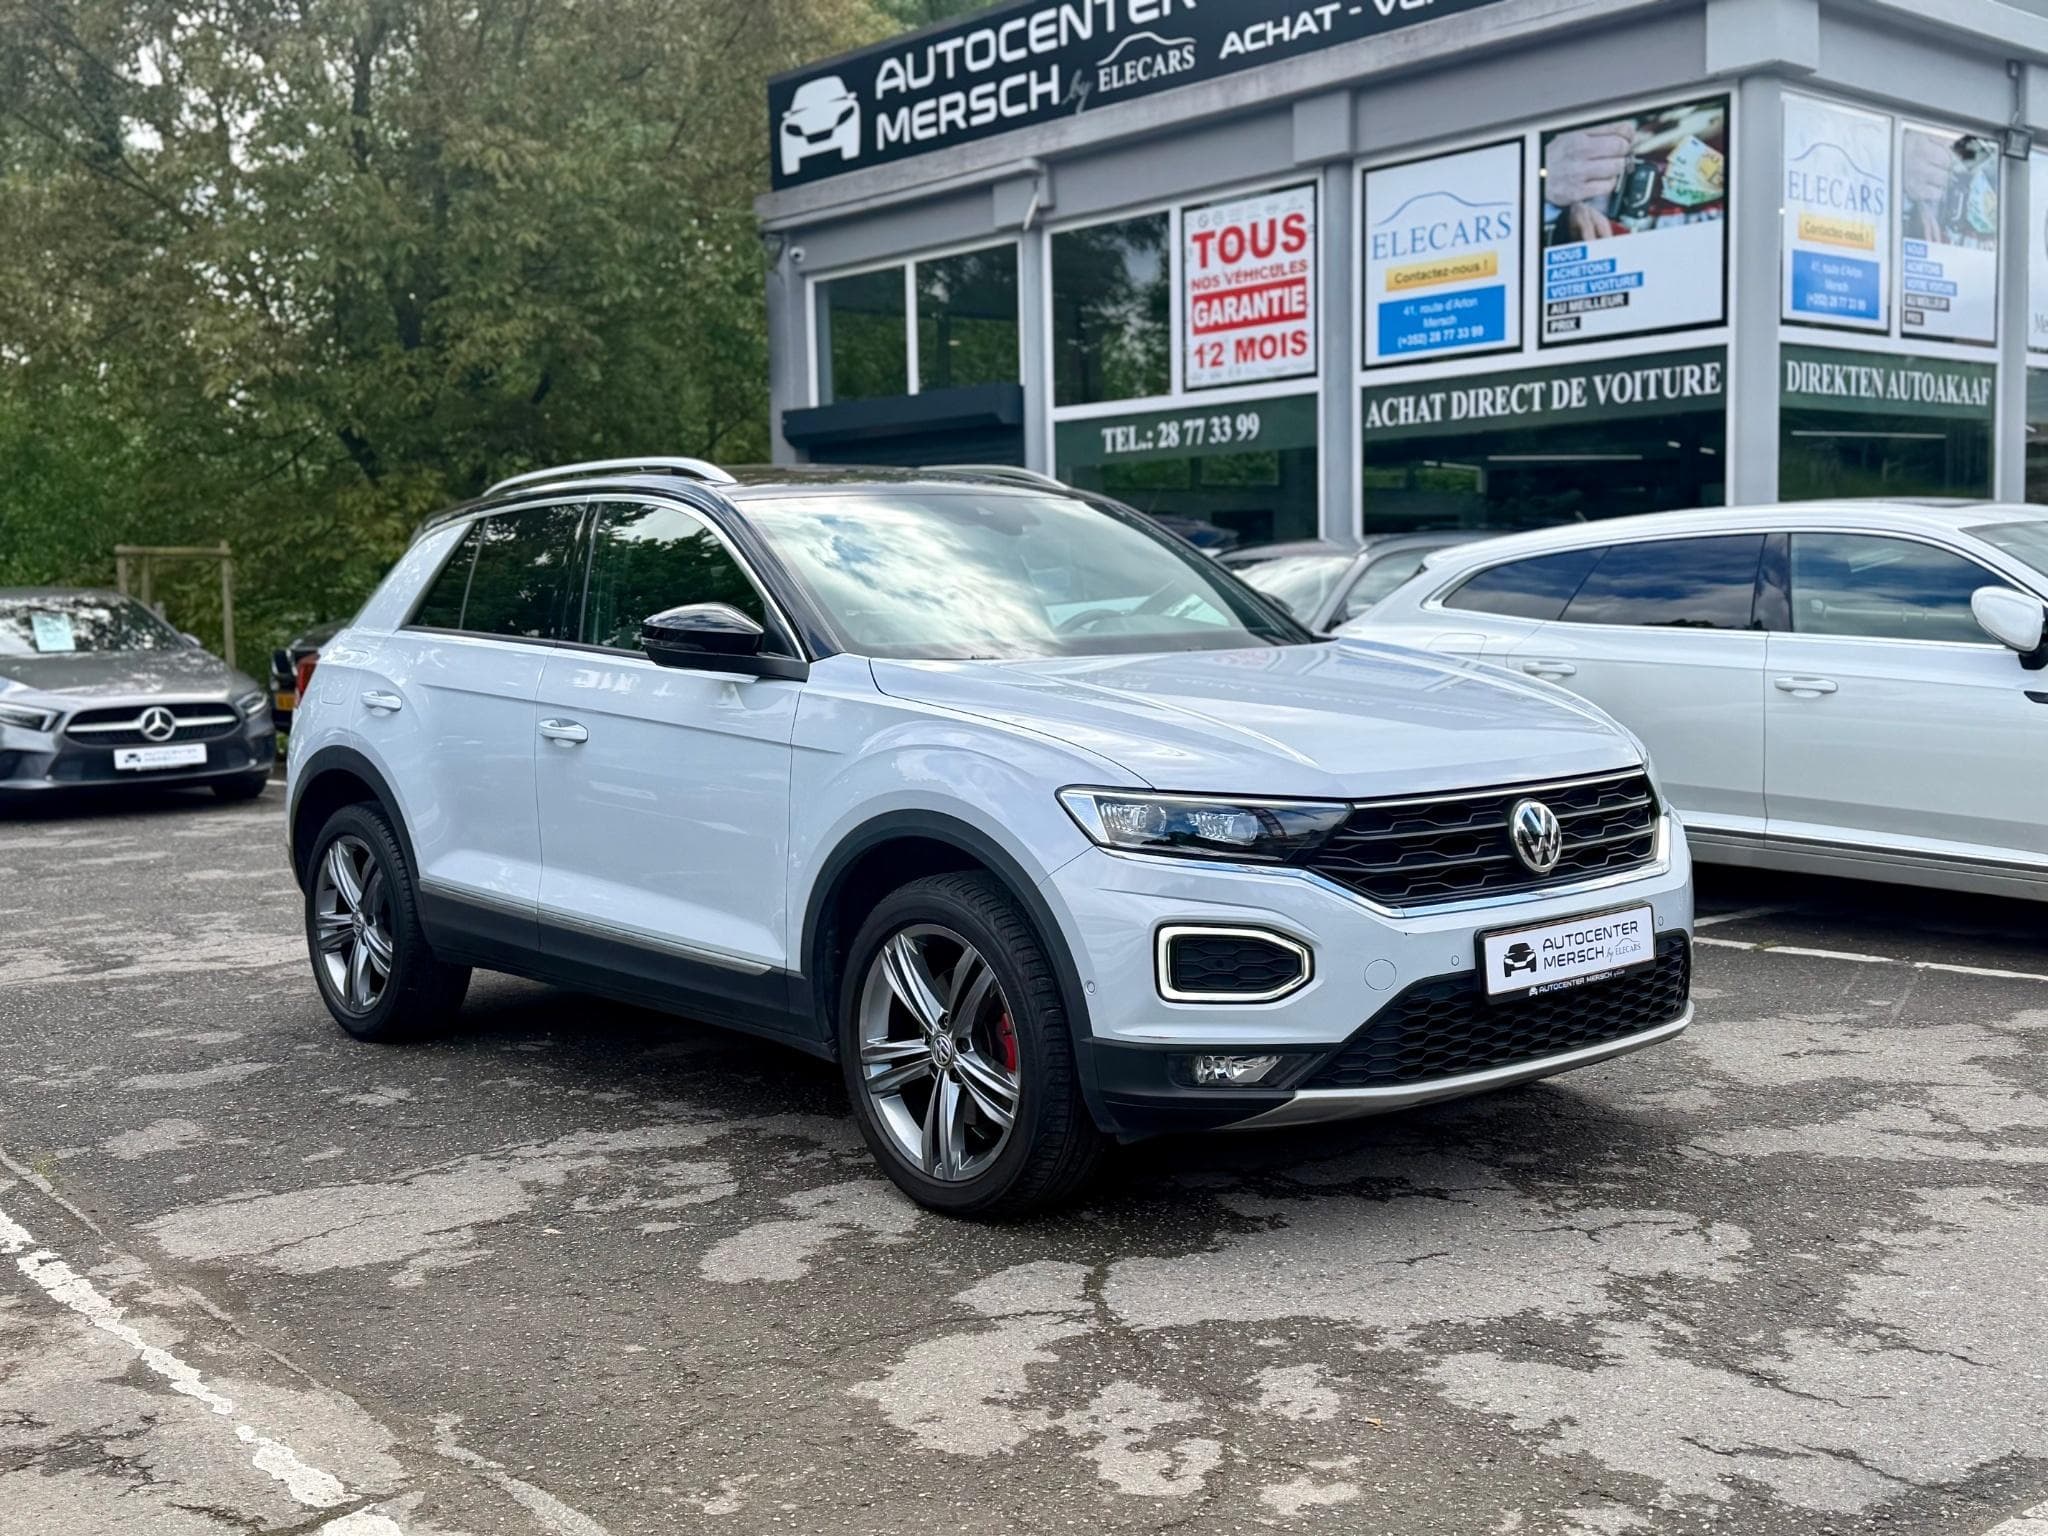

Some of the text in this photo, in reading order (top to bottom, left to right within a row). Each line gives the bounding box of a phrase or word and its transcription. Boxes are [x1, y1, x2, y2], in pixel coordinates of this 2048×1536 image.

[1218, 2, 1341, 60] ACHAT
[875, 64, 1061, 151] MERSCH
[1097, 44, 1196, 93] ELECARS
[1787, 169, 1884, 216] ELECARS
[1191, 212, 1308, 269] TOUS
[1371, 211, 1513, 261] ELECARS
[1191, 274, 1221, 291] NOS
[1193, 284, 1306, 329] GARANTIE
[1194, 329, 1308, 369] 12 MOIS
[1365, 362, 1723, 429] ACHAT DIRECT DE VOITURE
[1785, 360, 1992, 406] DIREKTEN AUTOAKAAF
[1101, 411, 1261, 454] TEL.: 28 77 33 99
[1542, 920, 1639, 953] AUTOCENTER
[1543, 945, 1605, 970] MERSCH
[1615, 943, 1641, 956] ELECARS
[1538, 977, 1585, 993] AUTOCENTER
[1586, 970, 1613, 983] MERSCH
